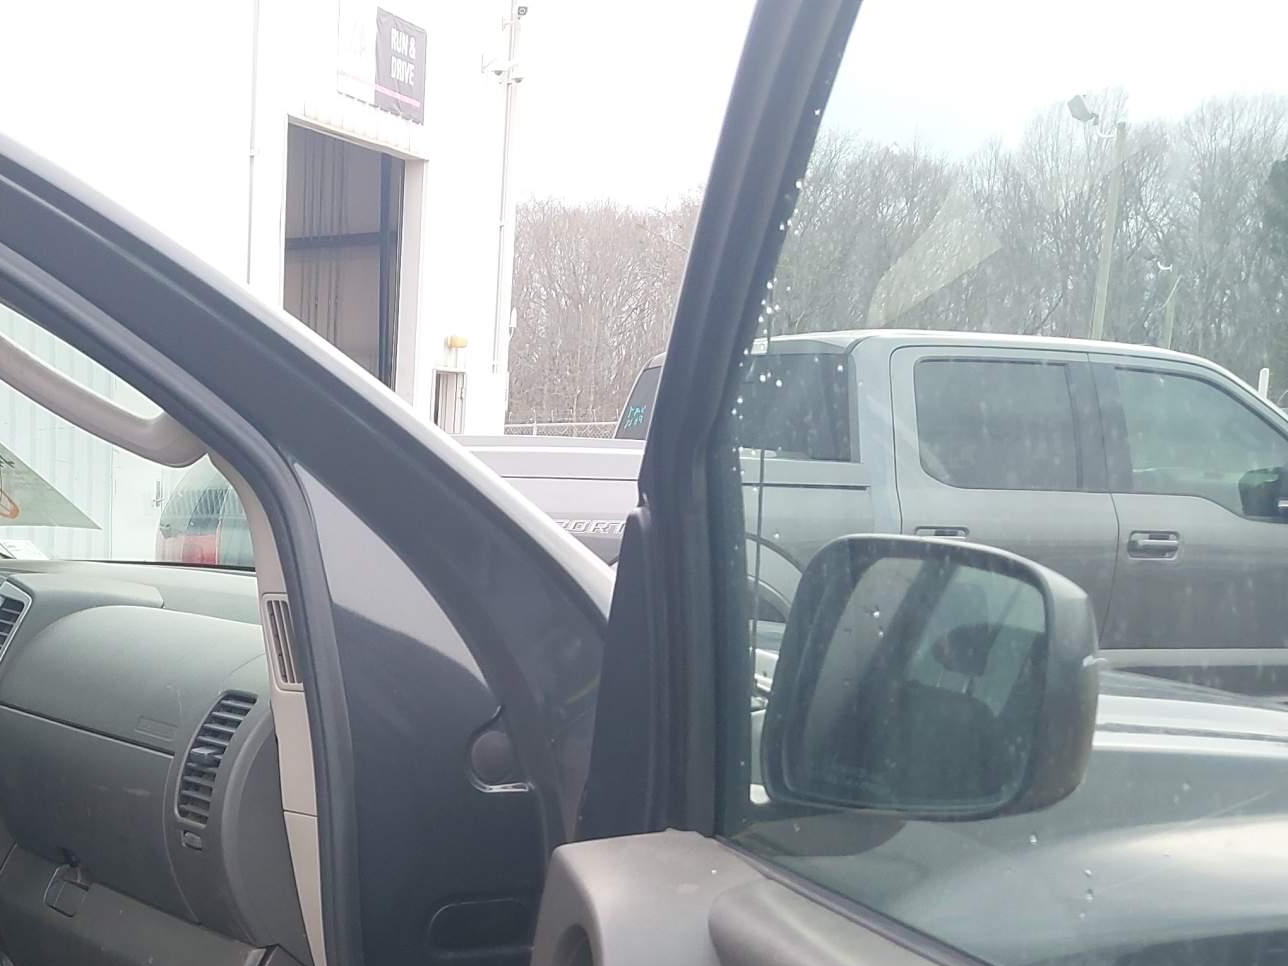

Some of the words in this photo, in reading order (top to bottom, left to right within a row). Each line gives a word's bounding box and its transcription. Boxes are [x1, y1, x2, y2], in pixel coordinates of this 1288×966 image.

[391, 27, 409, 56] RUN
[409, 37, 416, 60] &
[391, 55, 415, 86] DRIVE
